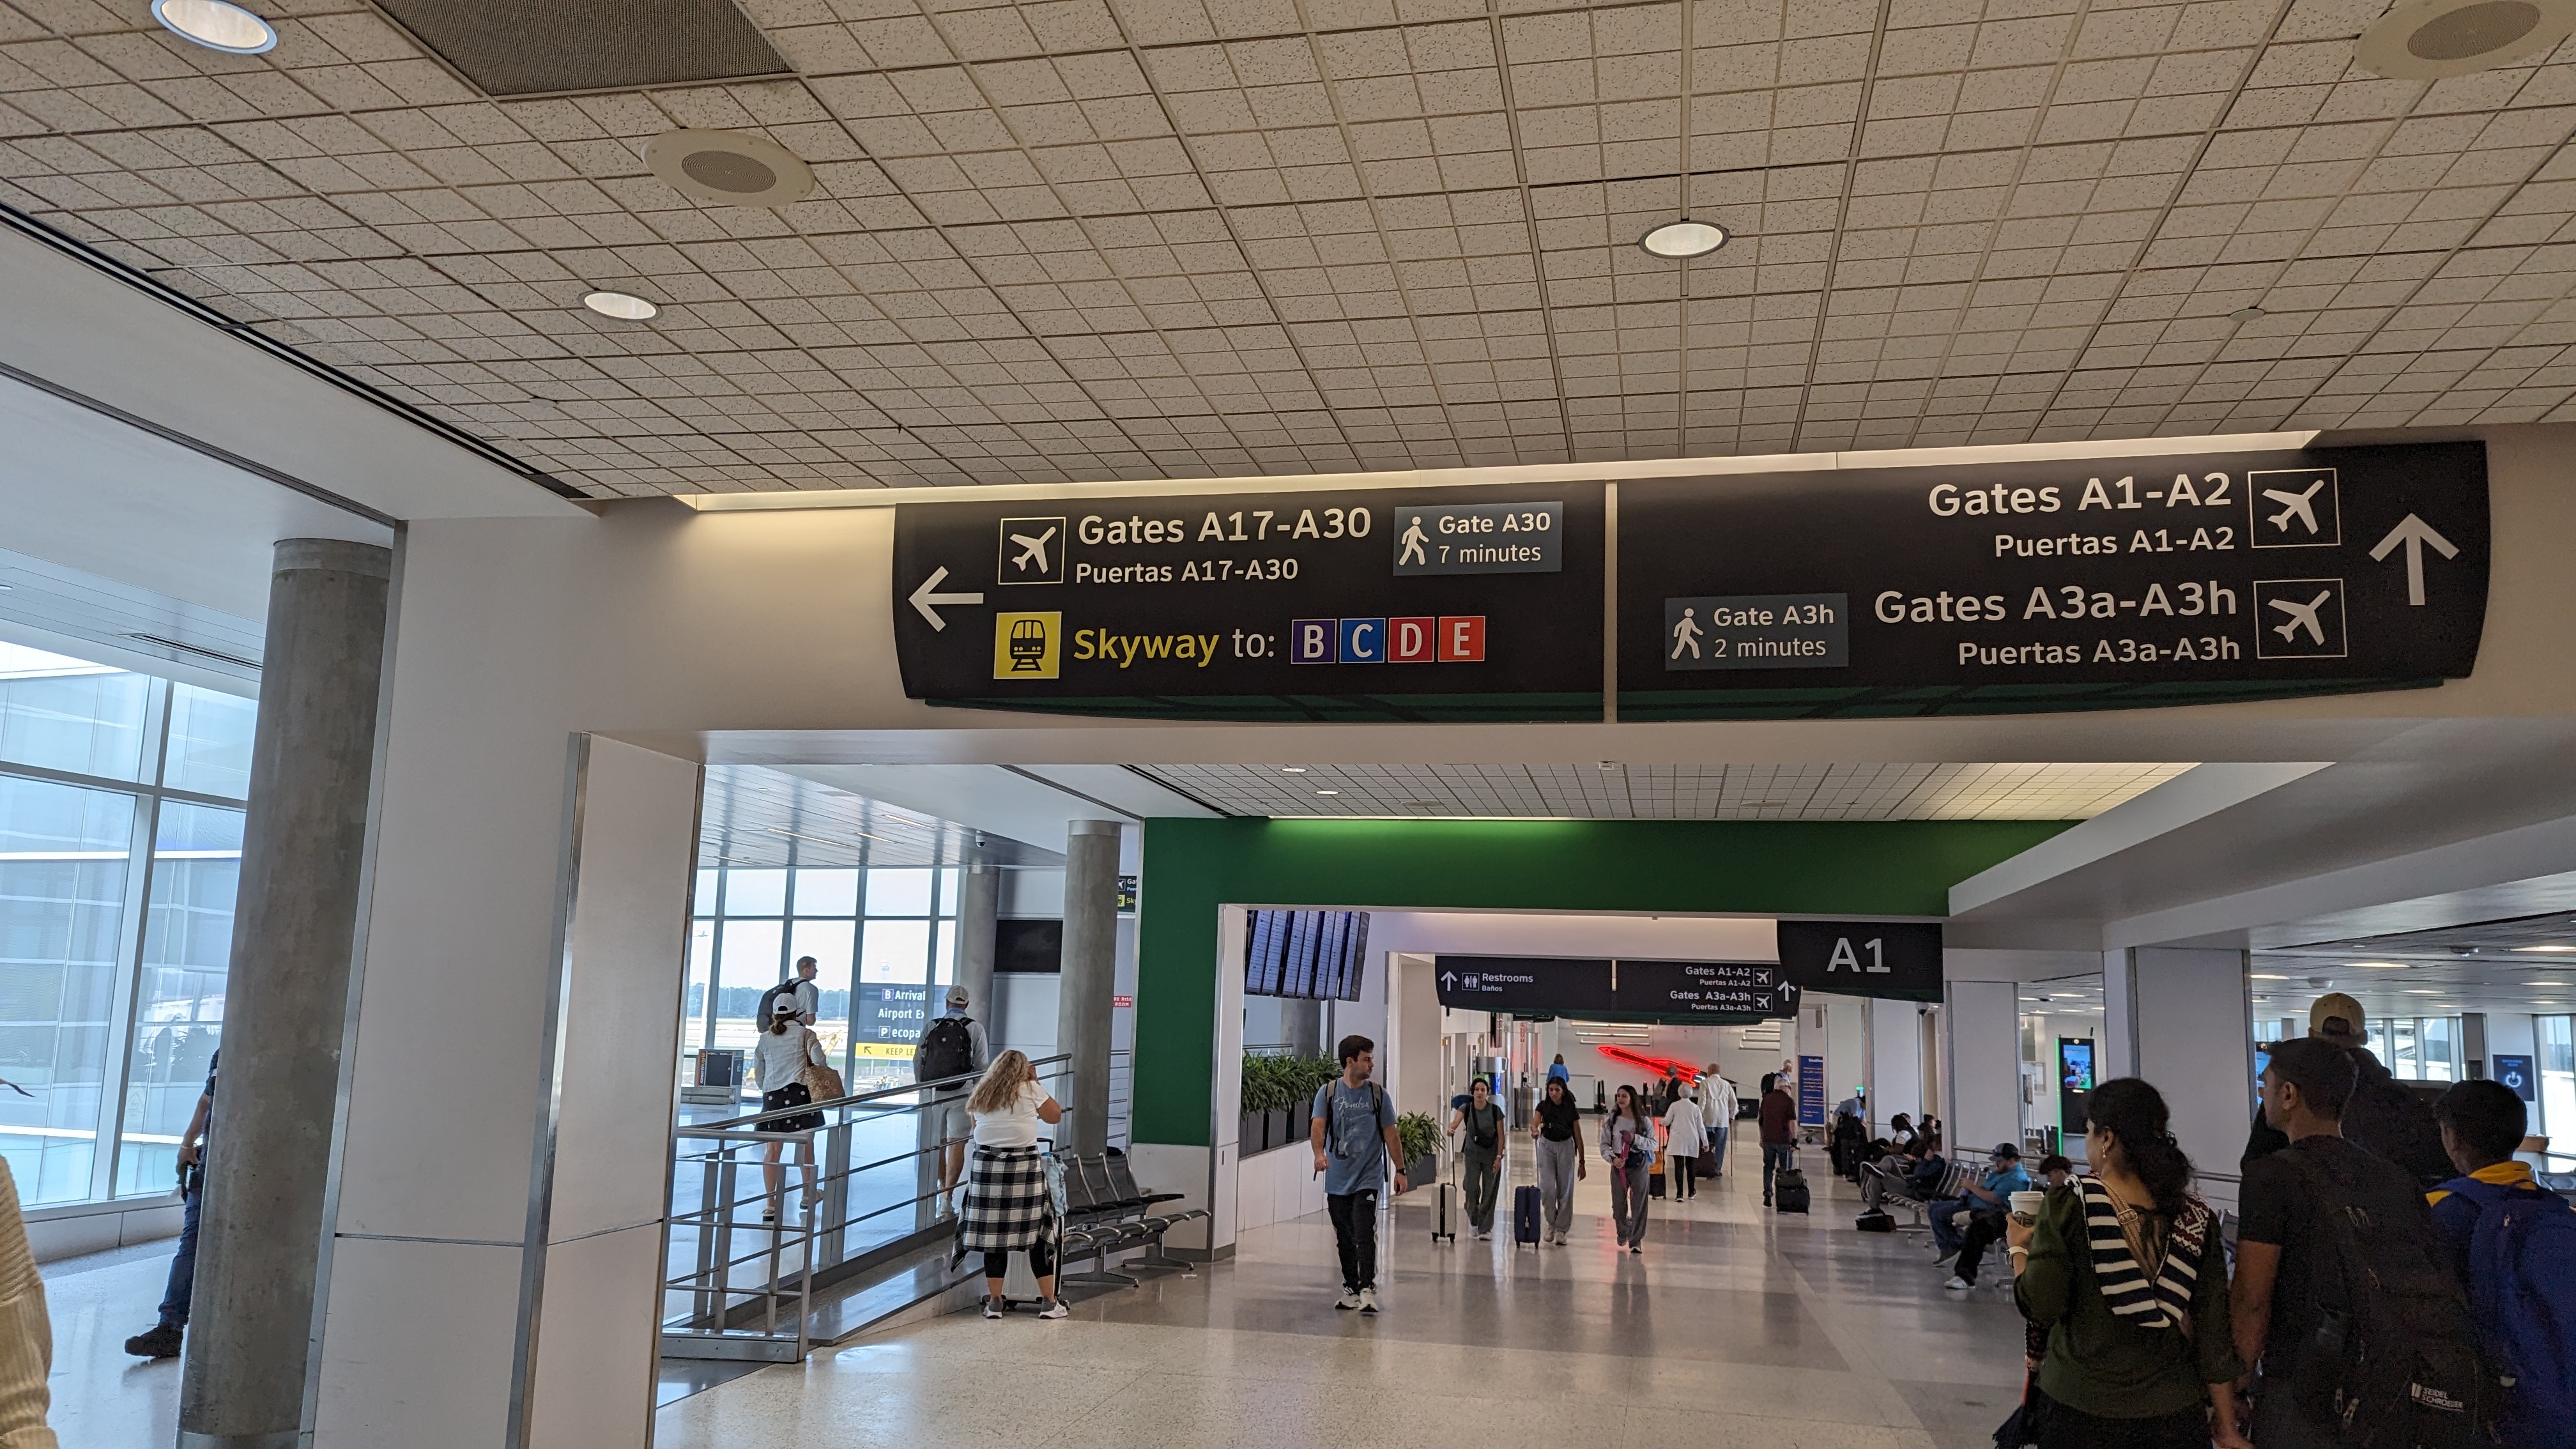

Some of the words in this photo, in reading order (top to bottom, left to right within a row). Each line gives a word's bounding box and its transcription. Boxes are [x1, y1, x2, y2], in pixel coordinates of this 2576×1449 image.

[1929, 483, 2061, 517] Gates
[2078, 472, 2232, 511] A1-A2
[1078, 516, 1184, 545] Gates
[1197, 507, 1371, 542] A17-A30
[1439, 515, 1494, 535] Gate
[1501, 512, 1551, 533] A30
[1995, 532, 2117, 558] Puertas
[2129, 526, 2235, 553] A1-A2
[1438, 546, 1450, 564] 7
[1459, 544, 1542, 563] minutes
[1077, 563, 1172, 584] Puertas
[1181, 558, 1298, 581] A17-A30
[1874, 590, 2006, 624] Gates
[2023, 580, 2237, 620] A3a-A3h
[1713, 608, 1773, 627] Gate
[1782, 604, 1834, 625] A3h
[1073, 628, 1220, 668] Skyway
[1232, 628, 1275, 657] to:
[1303, 624, 1324, 658] B
[1352, 624, 1374, 658] C
[1400, 623, 1423, 657] D
[1453, 622, 1470, 656] E
[1715, 639, 1726, 657] 2
[1737, 638, 1827, 657] minutes
[1959, 641, 2081, 666] Puertas
[2092, 636, 2240, 664] A3a-A3h
[1827, 937, 1890, 973] A1
[1482, 973, 1533, 983] Restrooms
[1685, 967, 1715, 976] Gates
[1717, 968, 1751, 977] A1-A2
[885, 990, 891, 999] B
[1670, 990, 1699, 1000] Gates
[1705, 992, 1751, 1002] A3a-A3h
[878, 1008, 912, 1020] Airport
[881, 1027, 888, 1036] P
[885, 1047, 903, 1055] KEEP
[1335, 1096, 1369, 1110] Fender
[2422, 1387, 2448, 1400] SEIDEL
